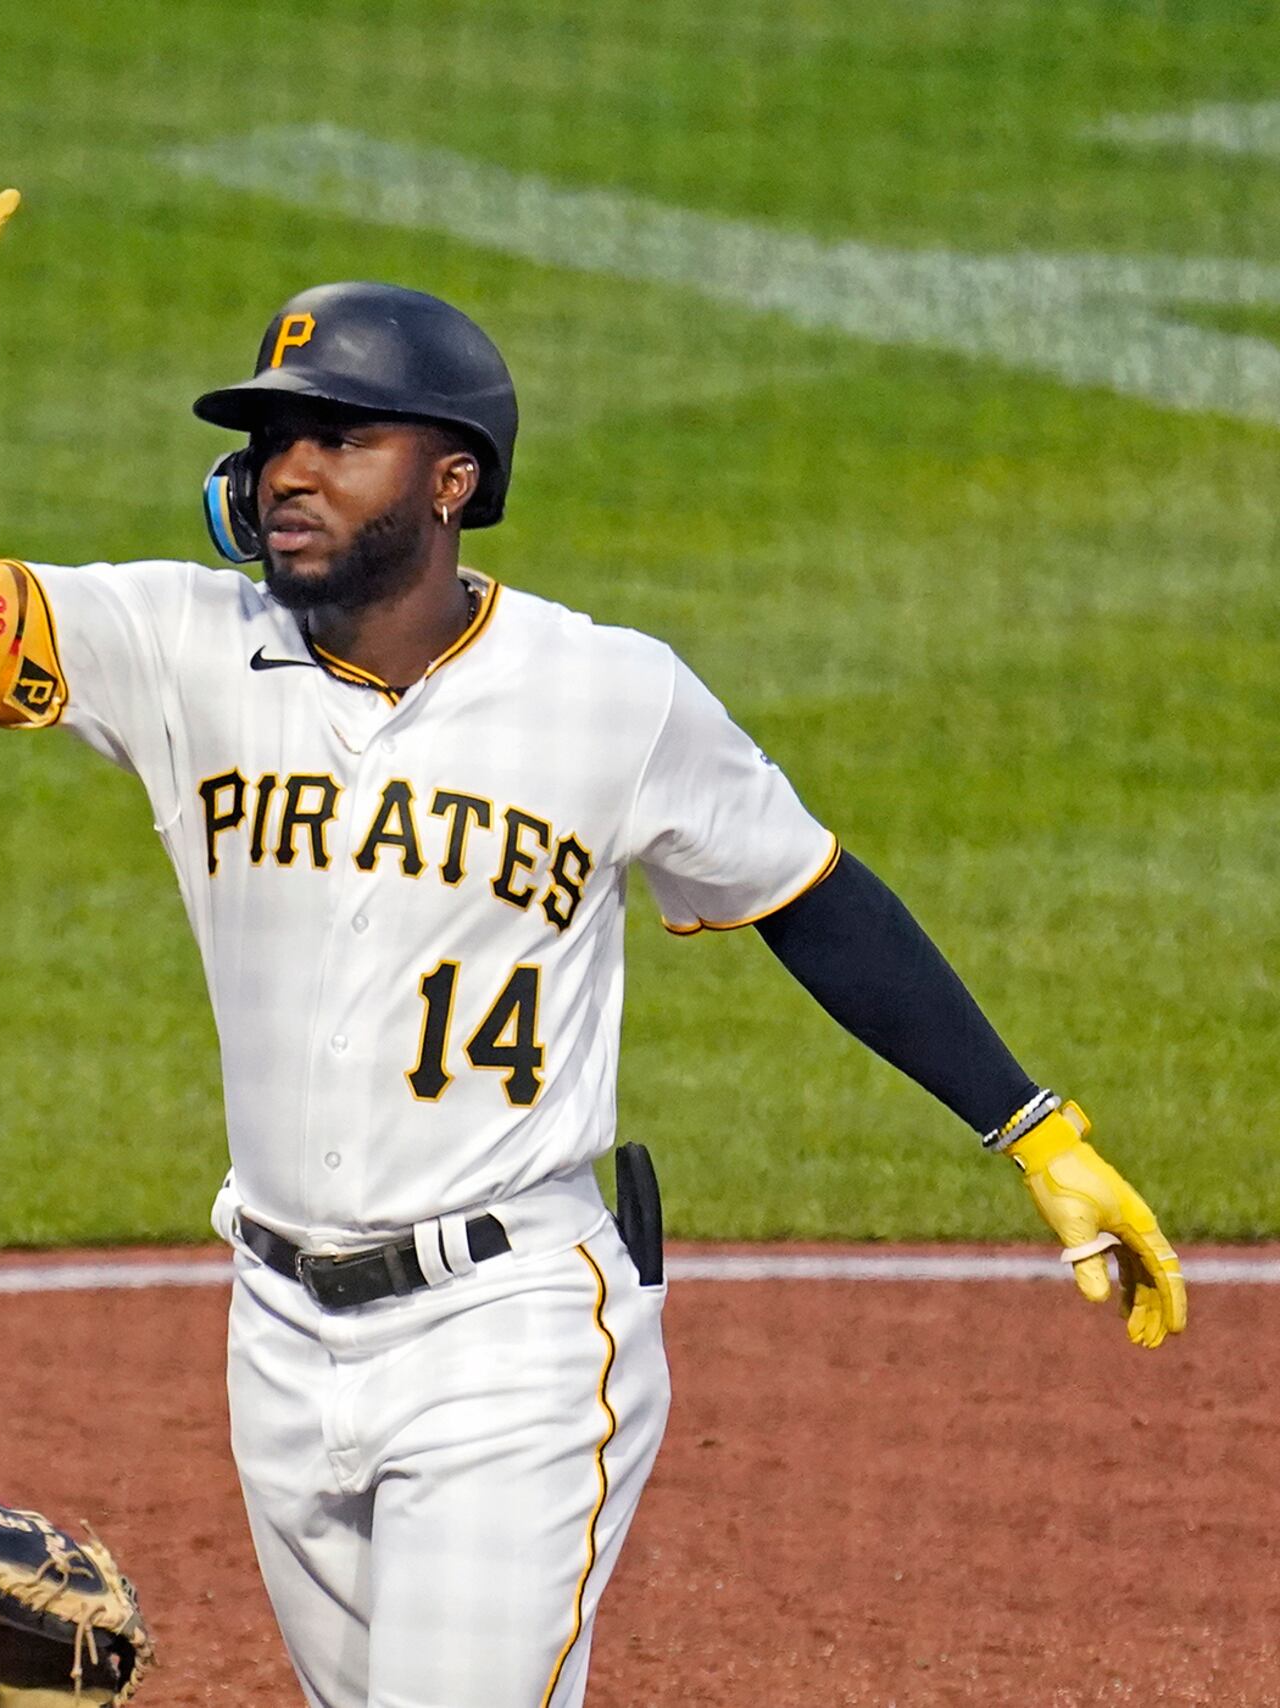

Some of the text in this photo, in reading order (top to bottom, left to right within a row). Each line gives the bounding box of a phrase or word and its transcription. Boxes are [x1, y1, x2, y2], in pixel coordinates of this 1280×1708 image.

[271, 312, 317, 369] P
[18, 676, 53, 706] P
[197, 766, 594, 937] PIRATES
[402, 959, 547, 1109] 14
